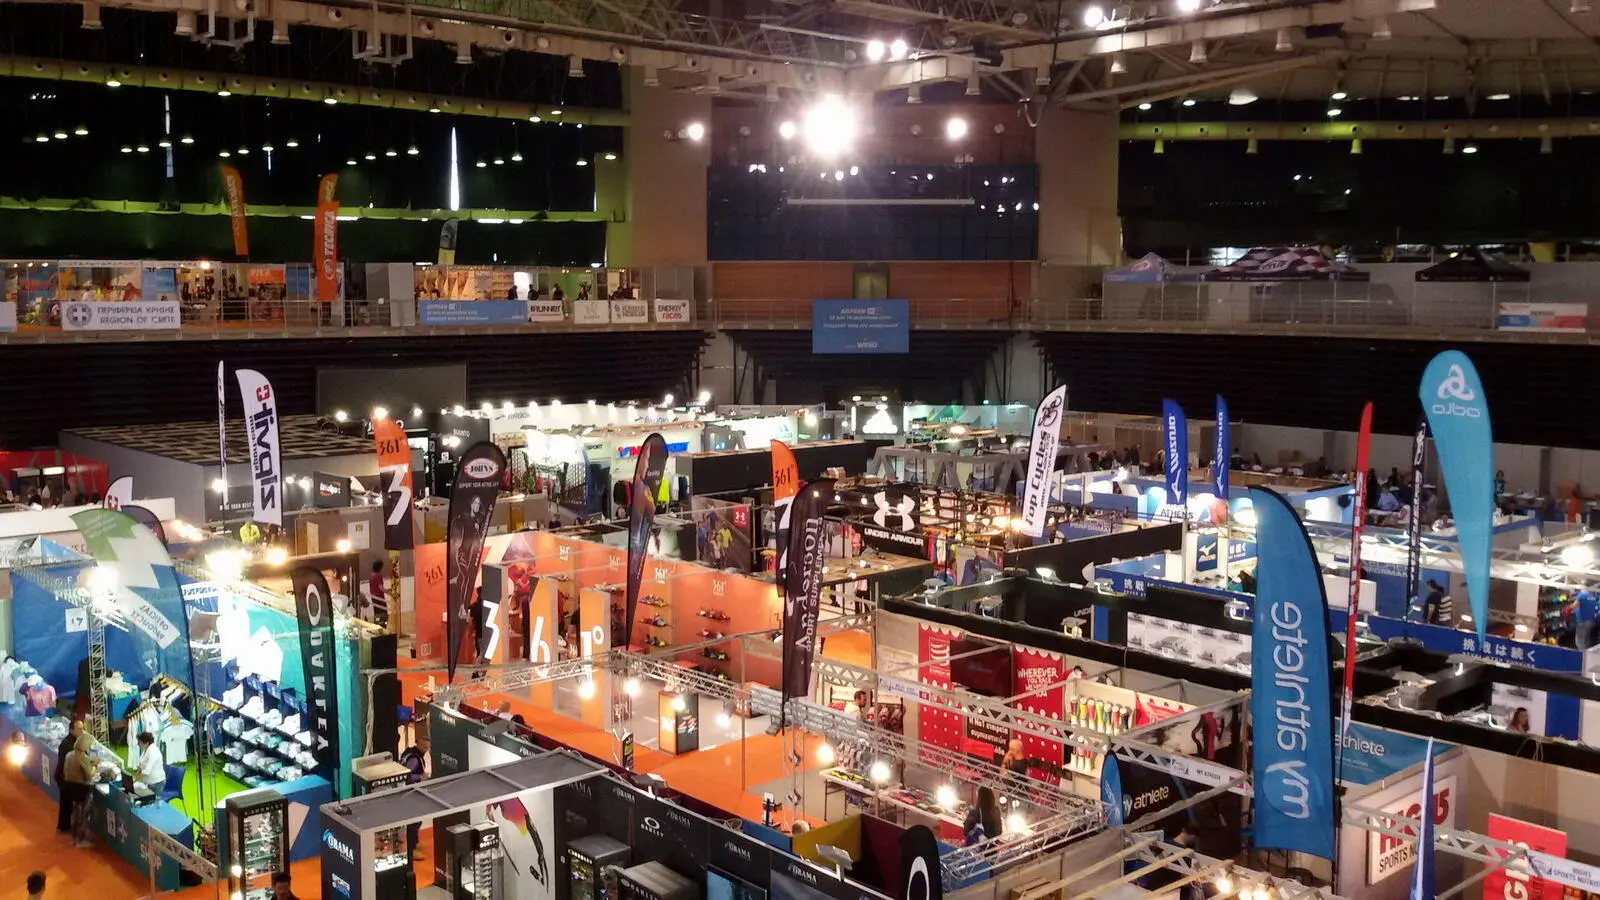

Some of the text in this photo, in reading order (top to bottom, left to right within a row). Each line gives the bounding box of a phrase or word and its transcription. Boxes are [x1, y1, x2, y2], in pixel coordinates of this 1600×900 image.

[864, 528, 923, 546] UNDER ARMOUR
[795, 517, 819, 650] Anderson
[483, 600, 500, 660] 3
[1017, 667, 1059, 679] WHEREVER
[1334, 734, 1385, 757] athlete
[1133, 786, 1169, 810] athlete
[1380, 788, 1450, 855] HIG5
[1379, 848, 1408, 873] SPORTS
